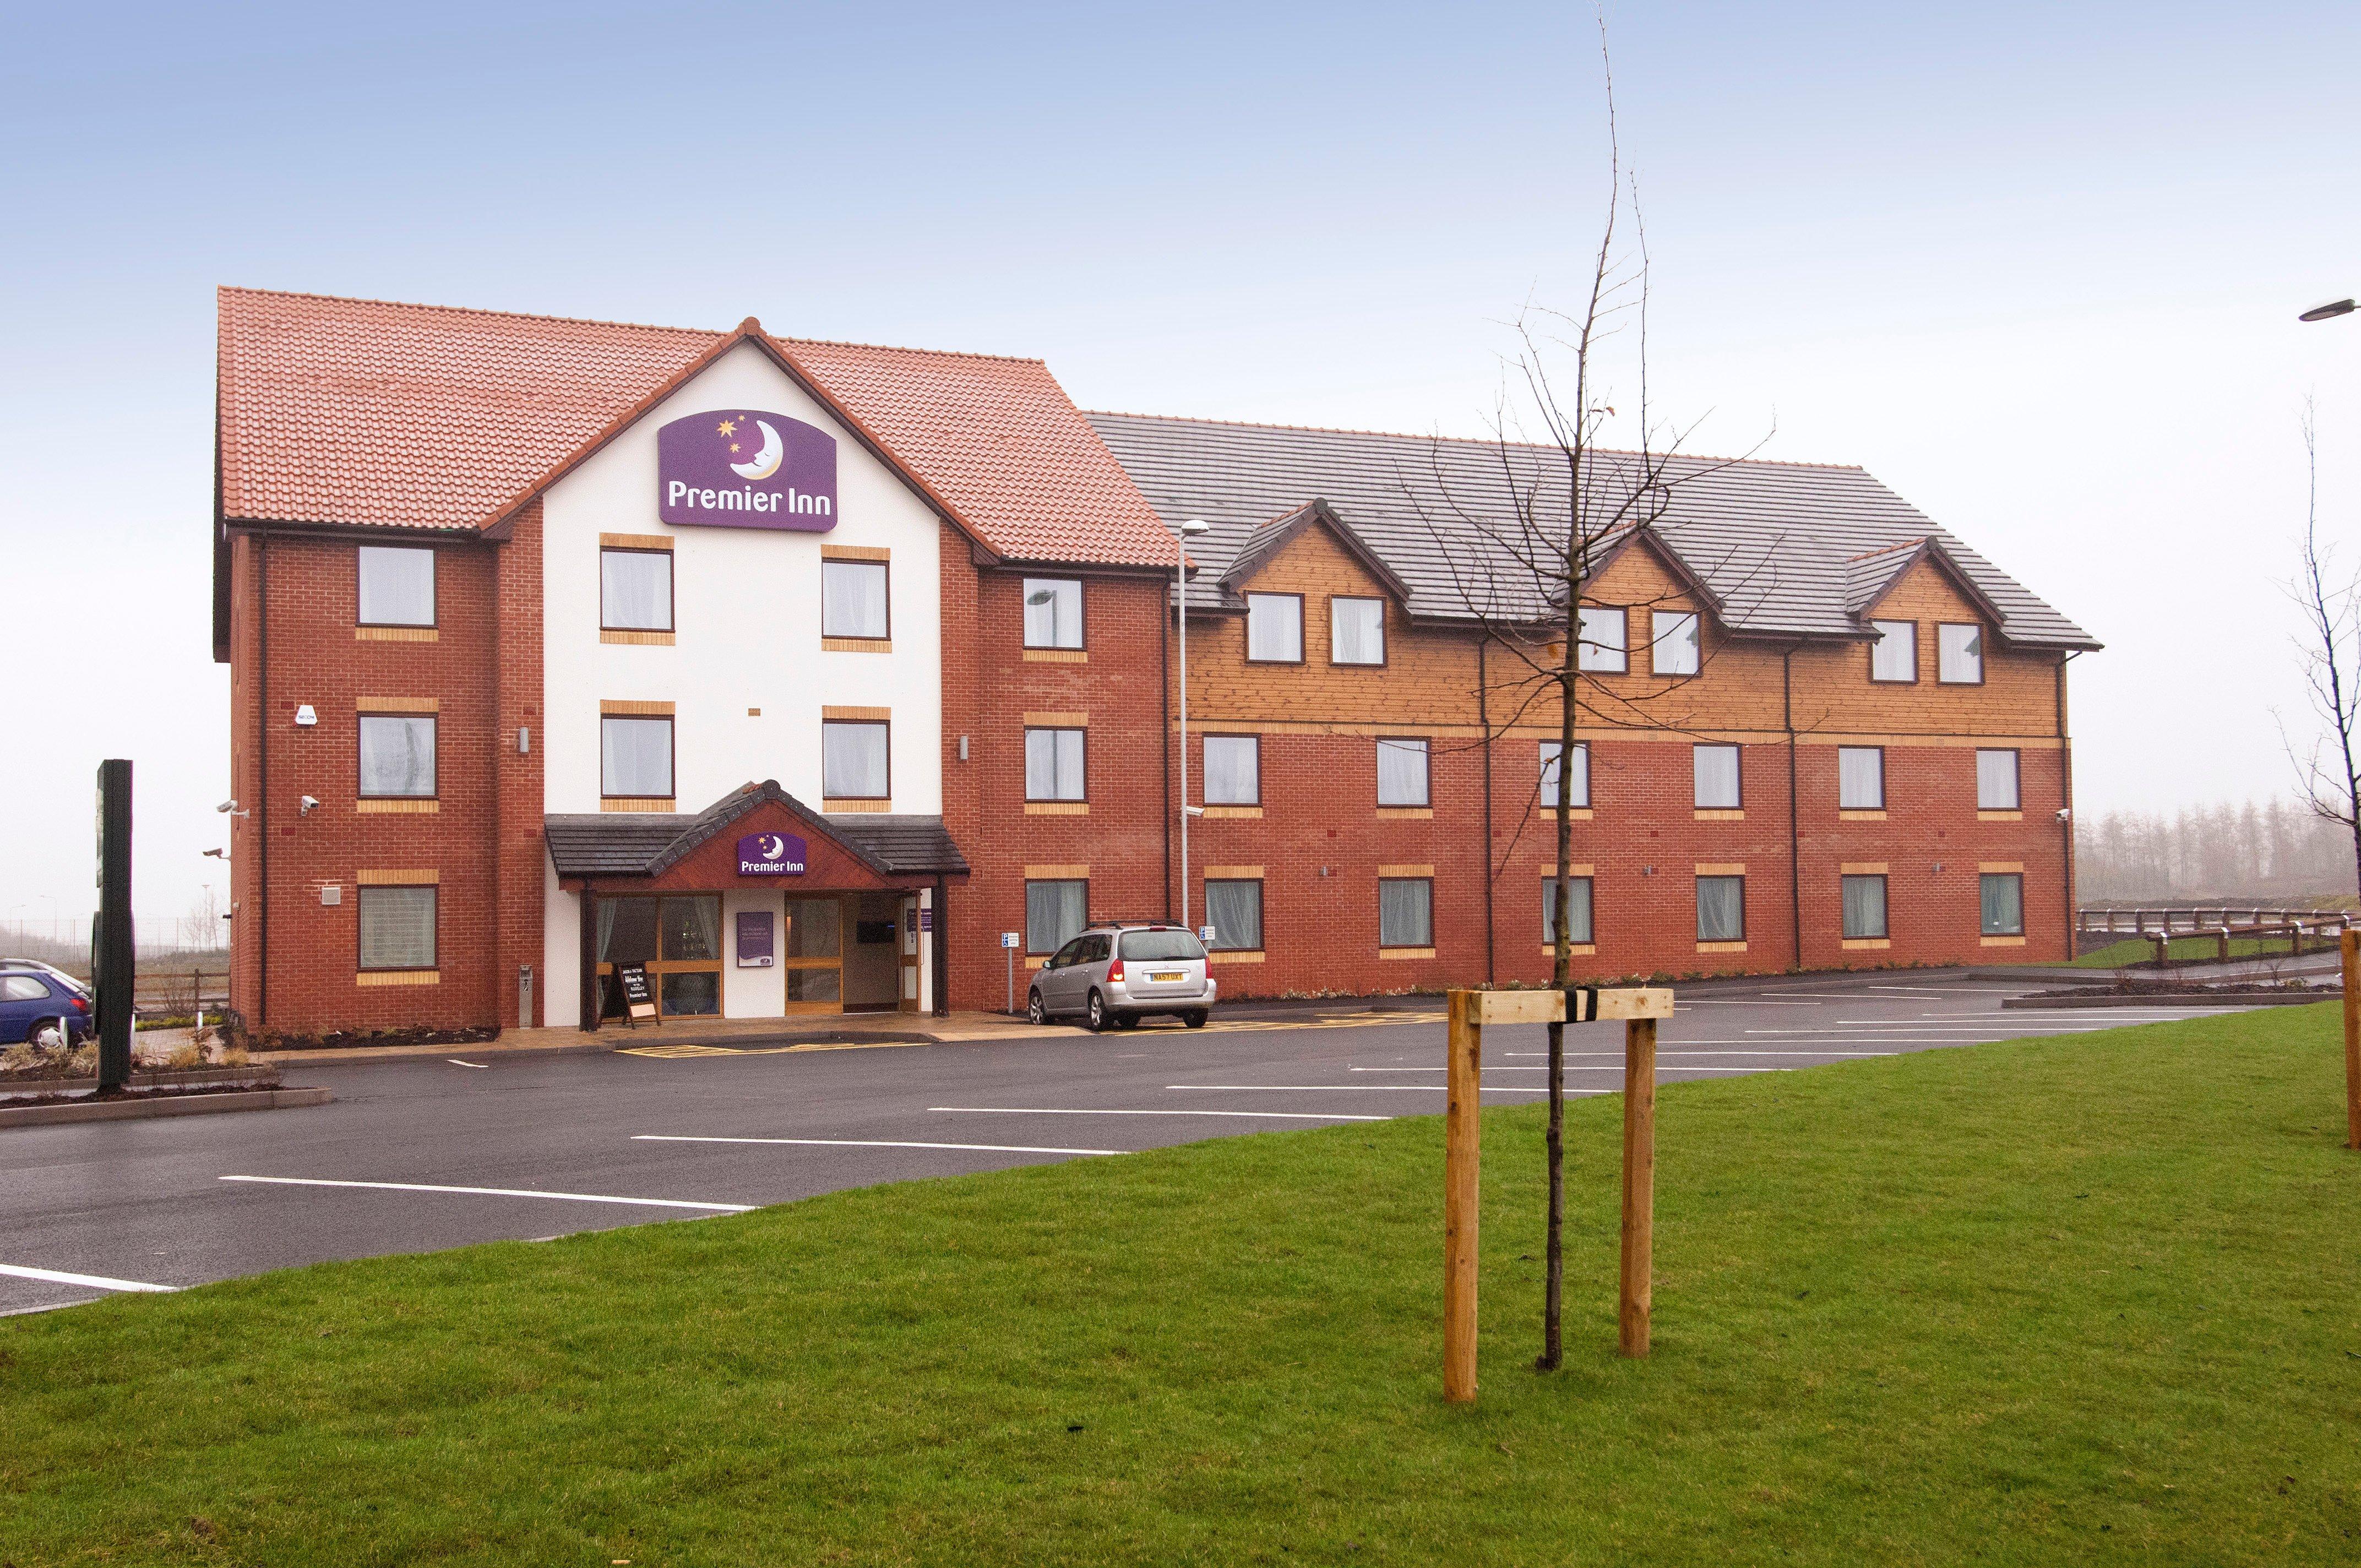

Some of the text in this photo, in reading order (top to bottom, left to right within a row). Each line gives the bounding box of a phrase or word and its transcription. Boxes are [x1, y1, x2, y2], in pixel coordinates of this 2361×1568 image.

[668, 480, 831, 515] Premier Inn
[742, 861, 804, 872] Premier Inn
